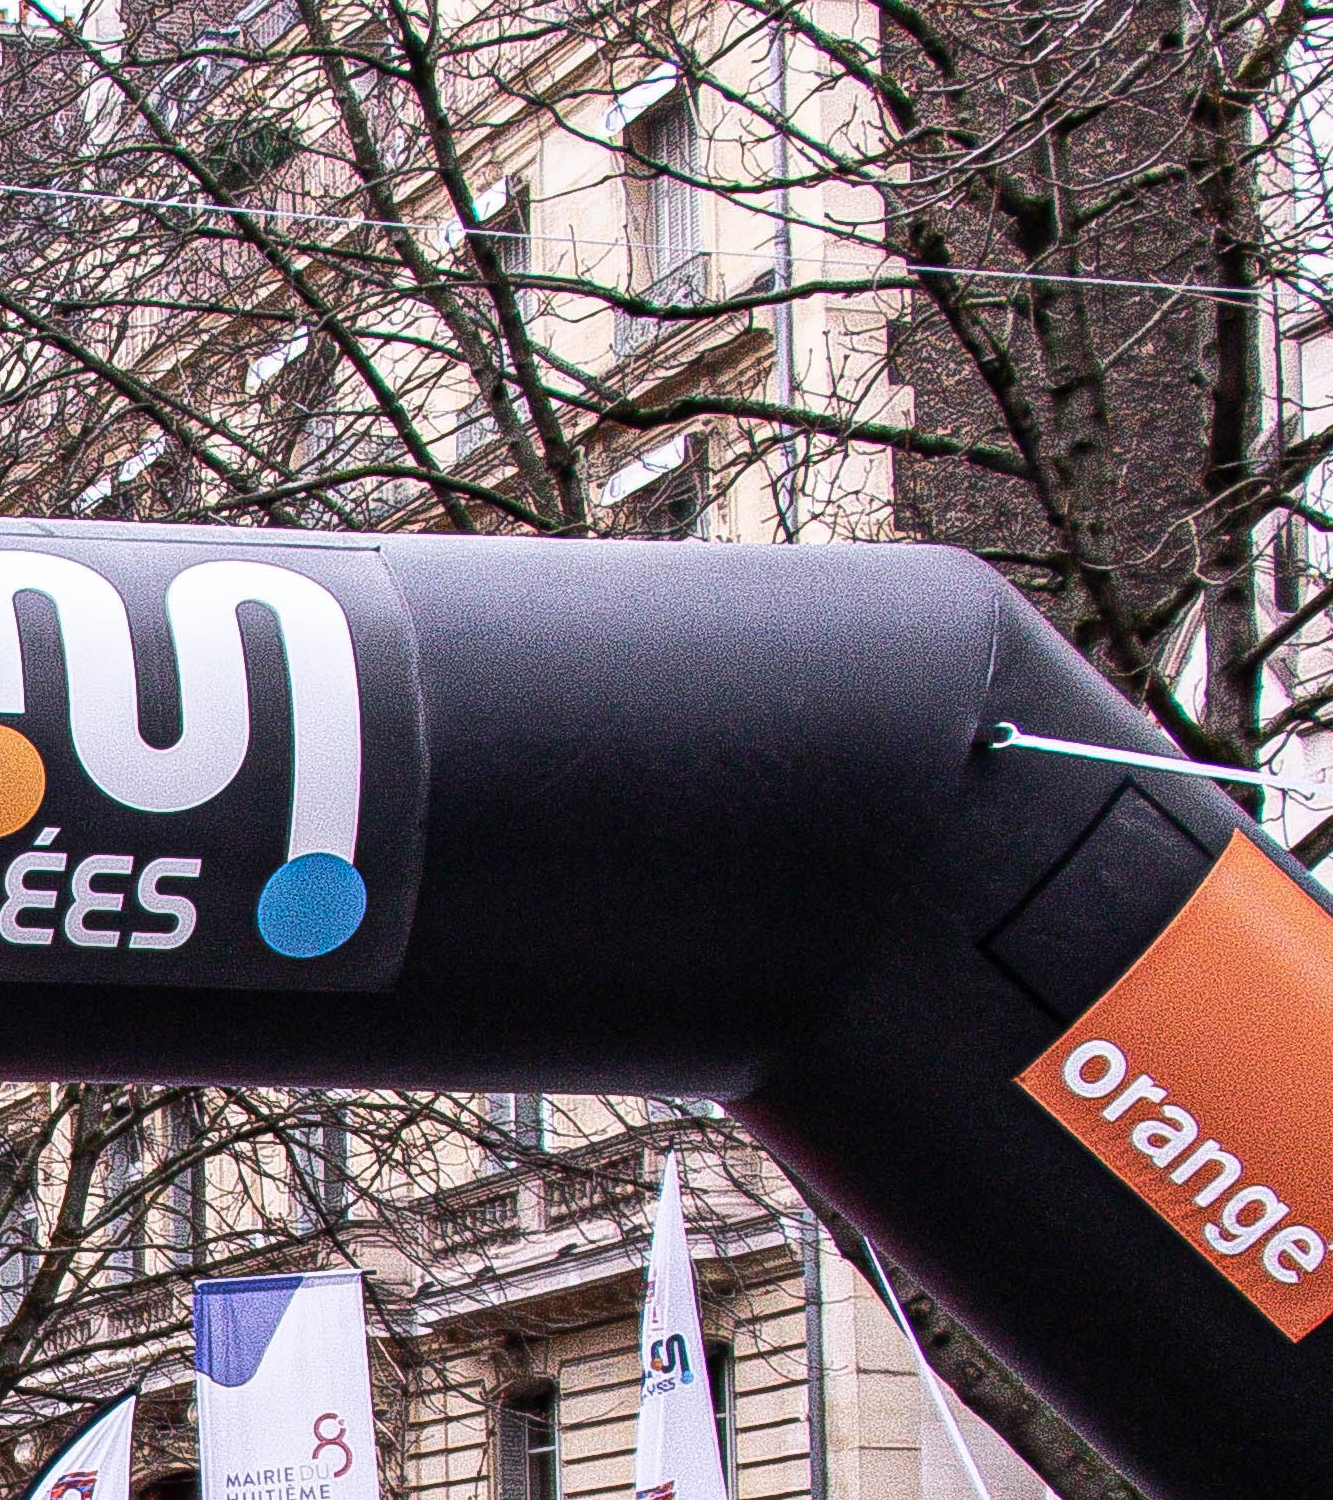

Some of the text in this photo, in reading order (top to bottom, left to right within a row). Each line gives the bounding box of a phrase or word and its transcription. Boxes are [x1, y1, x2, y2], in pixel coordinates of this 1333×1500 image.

[1060, 1037, 1329, 1285] orange
[225, 1465, 295, 1488] MAIRIE
[299, 1463, 330, 1481] DU
